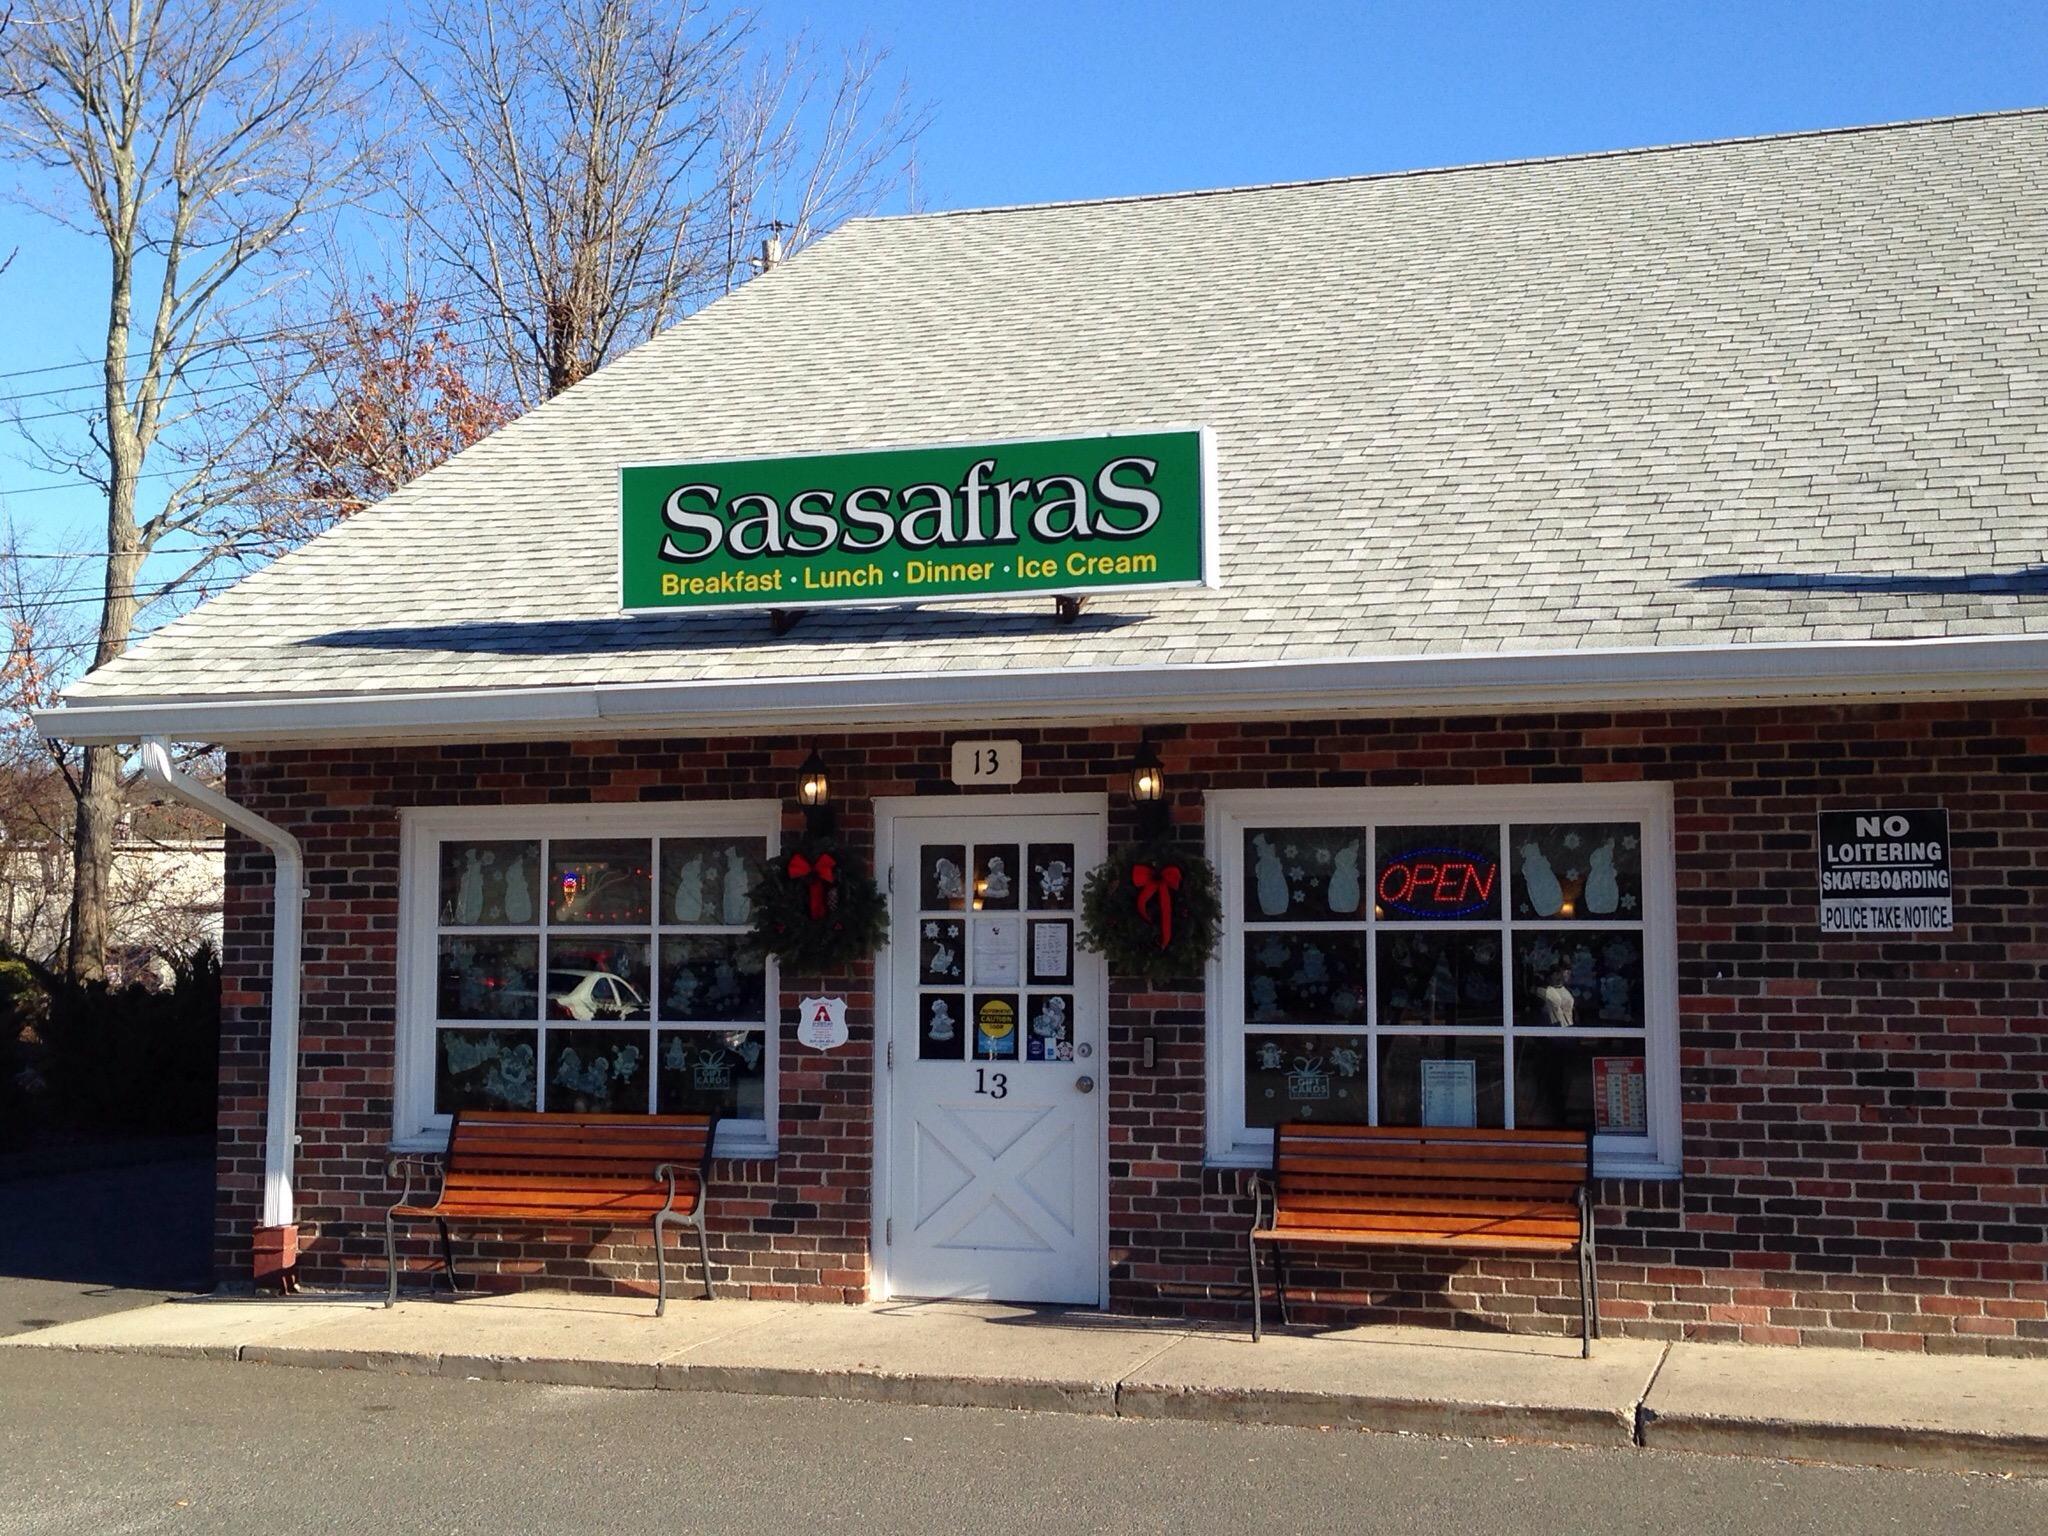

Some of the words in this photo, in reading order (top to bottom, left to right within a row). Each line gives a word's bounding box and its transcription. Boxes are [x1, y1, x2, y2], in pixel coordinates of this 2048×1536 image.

[660, 457, 1161, 564] SassafraS
[662, 569, 783, 596] Breakfast
[804, 563, 884, 589] Lunch
[906, 560, 995, 584] Dinner
[1017, 555, 1058, 578] Ice
[1066, 552, 1157, 576] Cream
[973, 749, 999, 775] 13
[1856, 815, 1910, 837] NO
[1827, 842, 1942, 863] LOITERING
[1378, 863, 1496, 902] OPEN
[1822, 869, 1949, 891] SKATEBOARDING
[1826, 906, 1868, 929] POLICE
[1870, 906, 1902, 929] TAKE
[1904, 905, 1948, 928] NOTICE
[980, 1015, 1012, 1023] CAUTION
[974, 1067, 1007, 1099] 13
